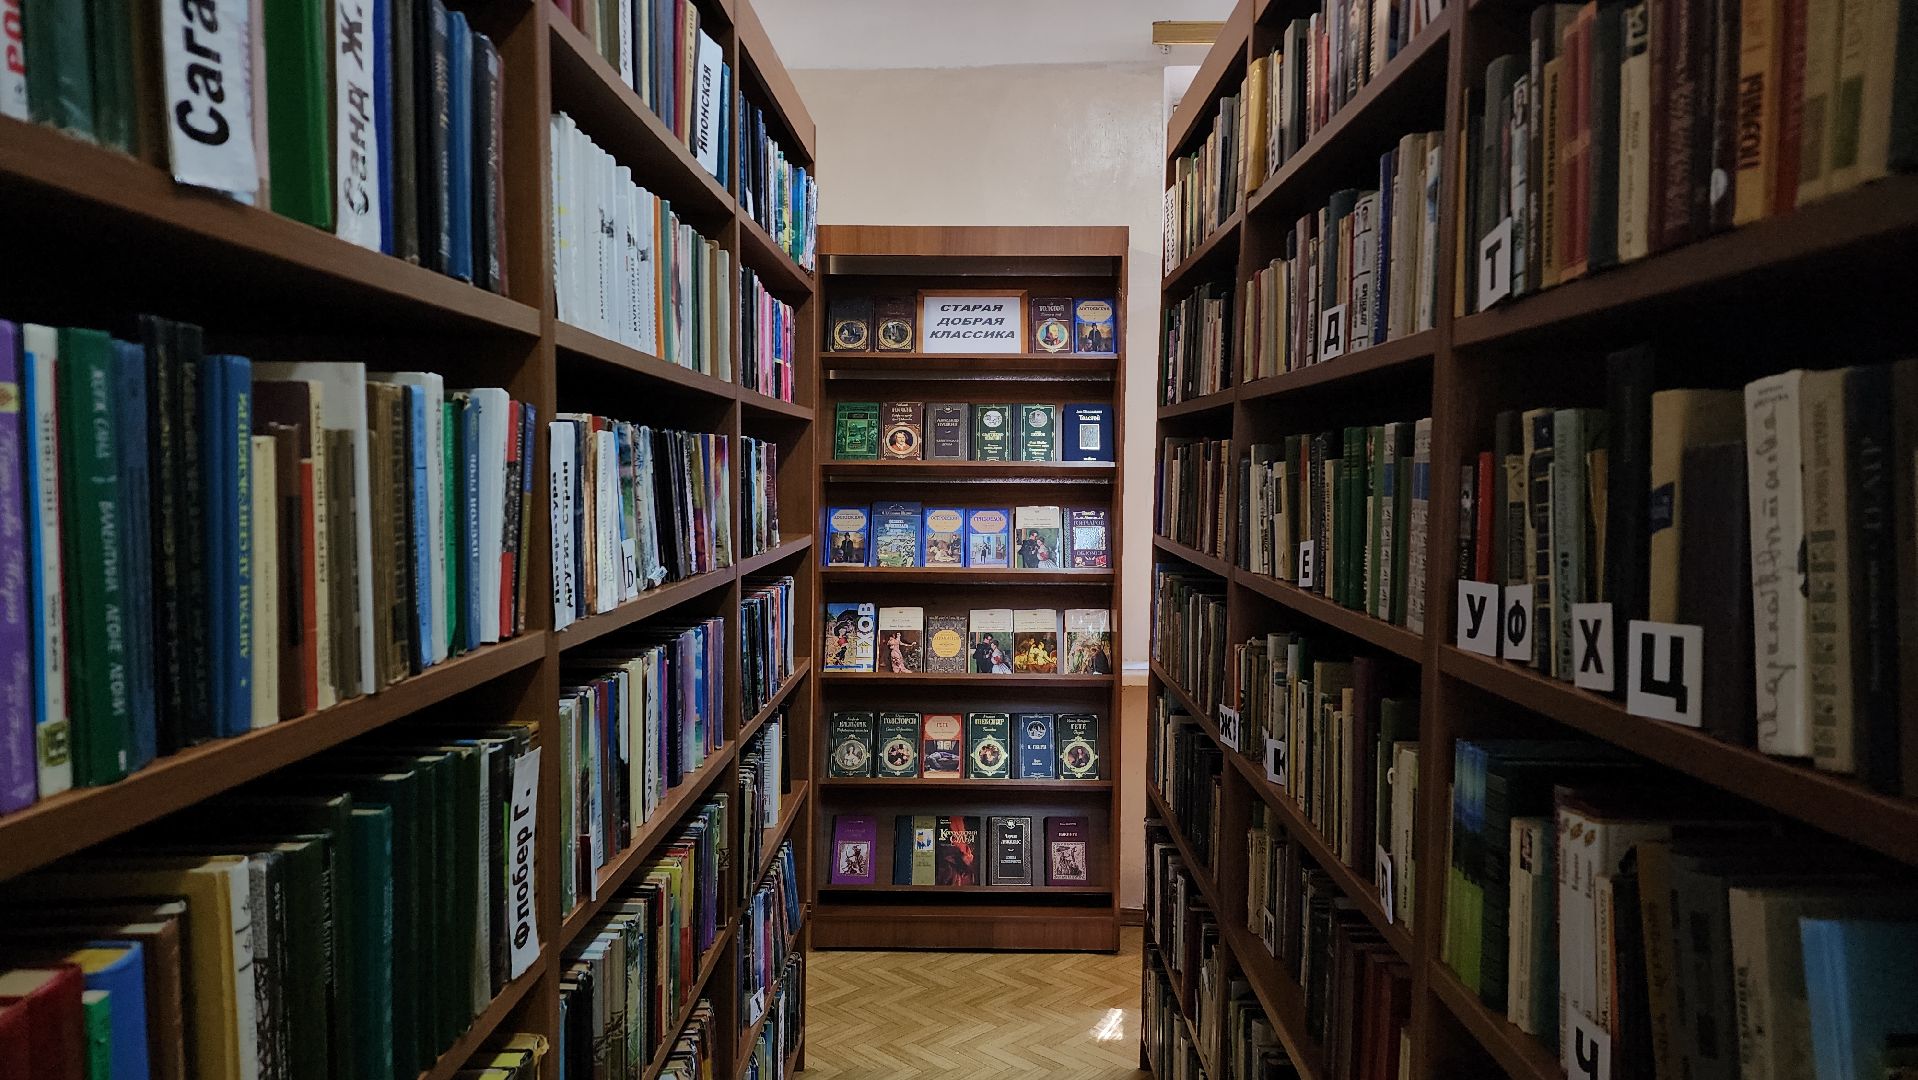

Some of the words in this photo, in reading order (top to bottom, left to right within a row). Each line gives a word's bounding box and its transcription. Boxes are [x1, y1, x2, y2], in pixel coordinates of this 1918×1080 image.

[695, 63, 714, 155] Японская
[343, 82, 370, 215] Санд
[1485, 236, 1502, 291] Т
[936, 317, 1006, 326] ДОБРАЯ
[940, 303, 1004, 313] СТАРАЯ
[1323, 311, 1340, 355] Д
[929, 330, 1016, 340] КЛАССИКА
[1302, 549, 1310, 579] Е
[855, 602, 874, 673] ЧЕХОВ
[1466, 592, 1487, 639] У
[1507, 598, 1527, 646] Ф
[1580, 619, 1603, 674] Х
[1640, 632, 1688, 713] Ц
[1220, 711, 1232, 741] Ж
[513, 823, 533, 950] Флобер
[1575, 1026, 1599, 1080] Ч
